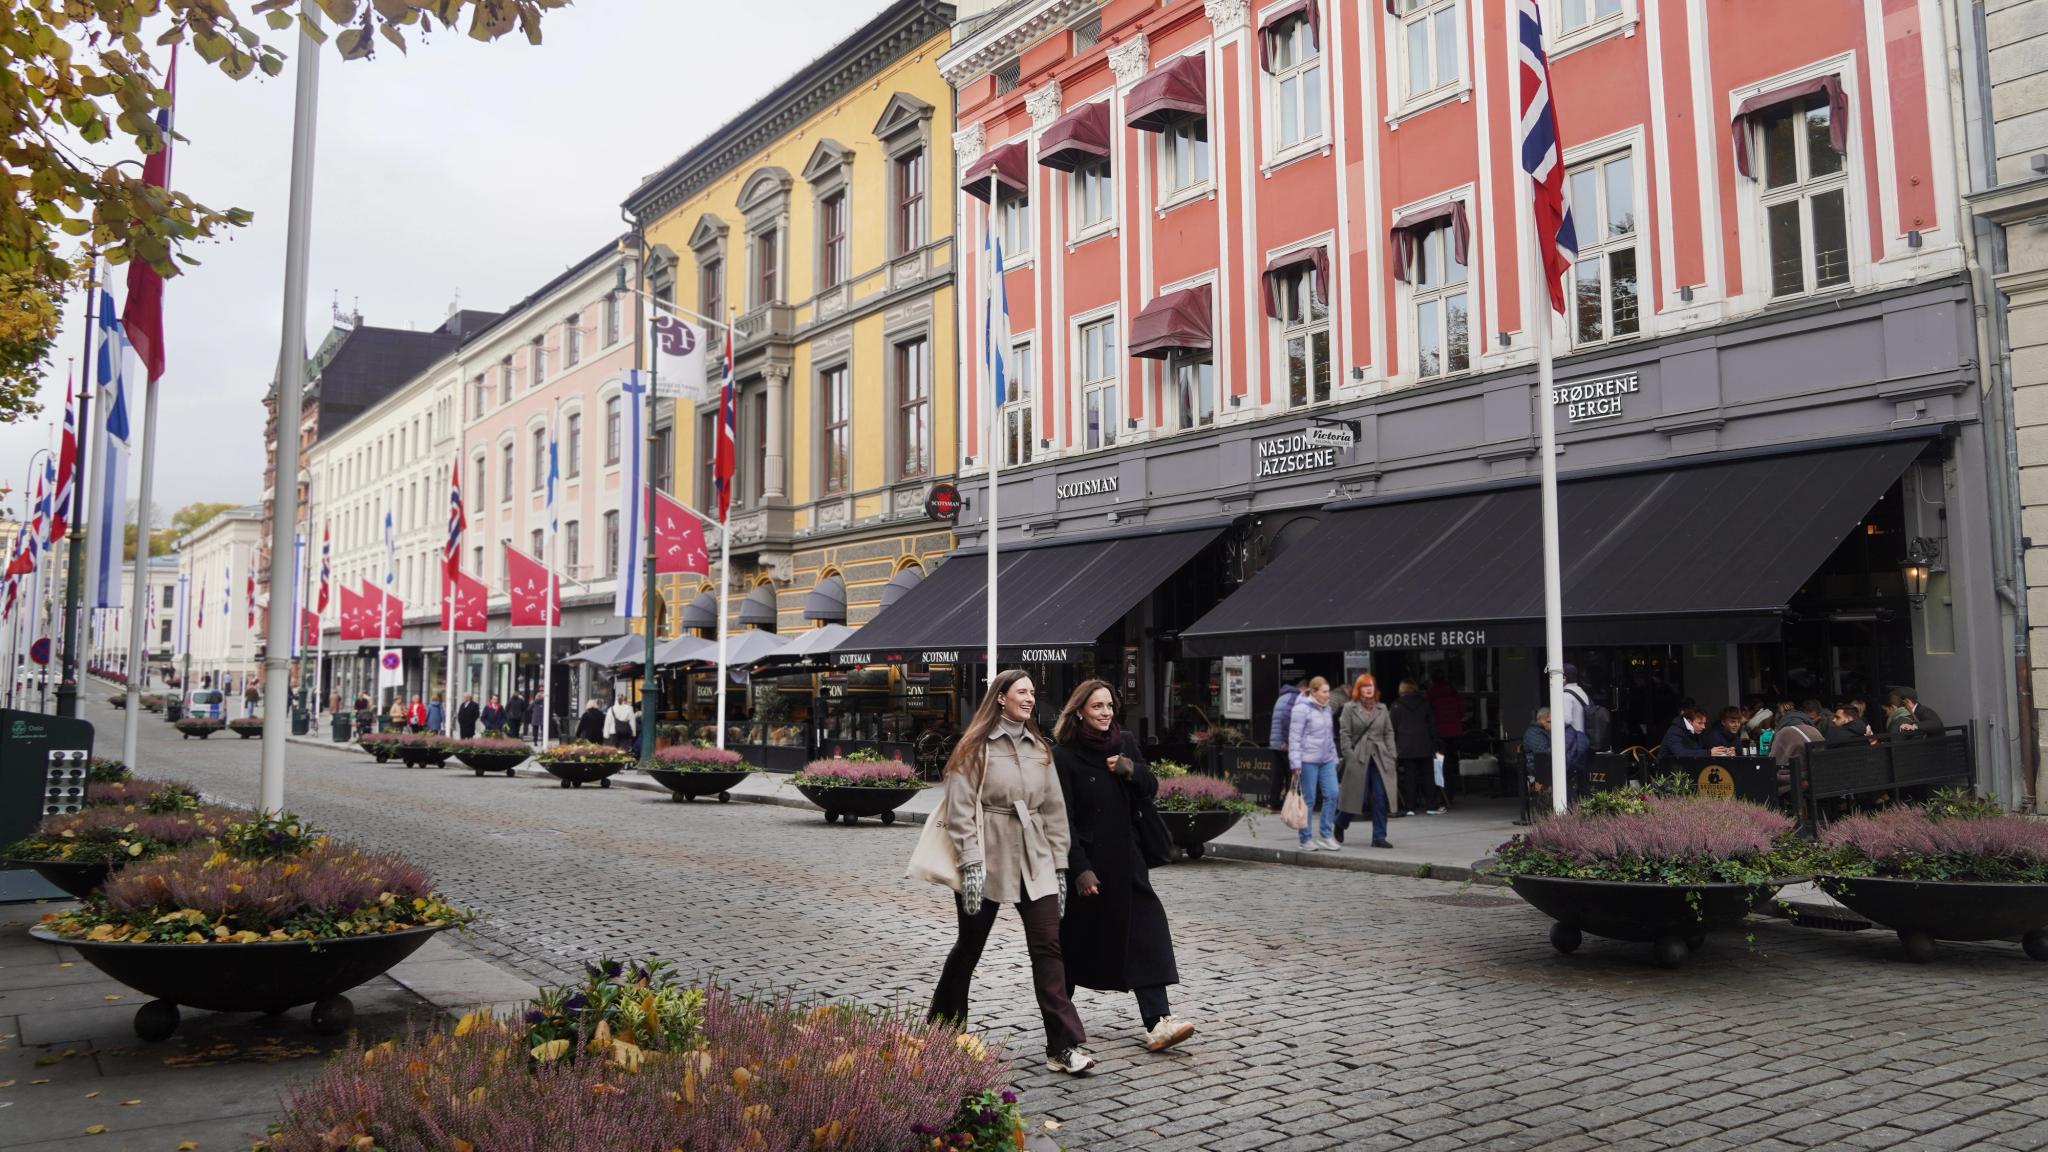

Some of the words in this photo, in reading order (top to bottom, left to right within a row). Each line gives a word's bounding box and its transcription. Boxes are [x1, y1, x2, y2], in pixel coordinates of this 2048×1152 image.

[1553, 376, 1638, 404] BRØDRENE
[1568, 397, 1621, 419] BERGH
[1313, 430, 1351, 442] Victoria
[1258, 434, 1326, 458] NASJON
[1256, 449, 1334, 477] JAZZSCENE
[1057, 476, 1118, 499] SCOTSMAN
[1368, 632, 1436, 648] BRØDRENE
[1441, 630, 1486, 645] BERGH
[465, 642, 485, 651] PALEET
[495, 642, 523, 650] SHOPPING
[839, 653, 872, 664] SCOTSMAN
[921, 651, 960, 663] SCOTSMAN
[1022, 649, 1068, 662] SCOTSMAN
[697, 686, 713, 696] EGON
[906, 686, 924, 695] GON
[1236, 757, 1252, 769] Live
[1253, 757, 1273, 770] Jazz
